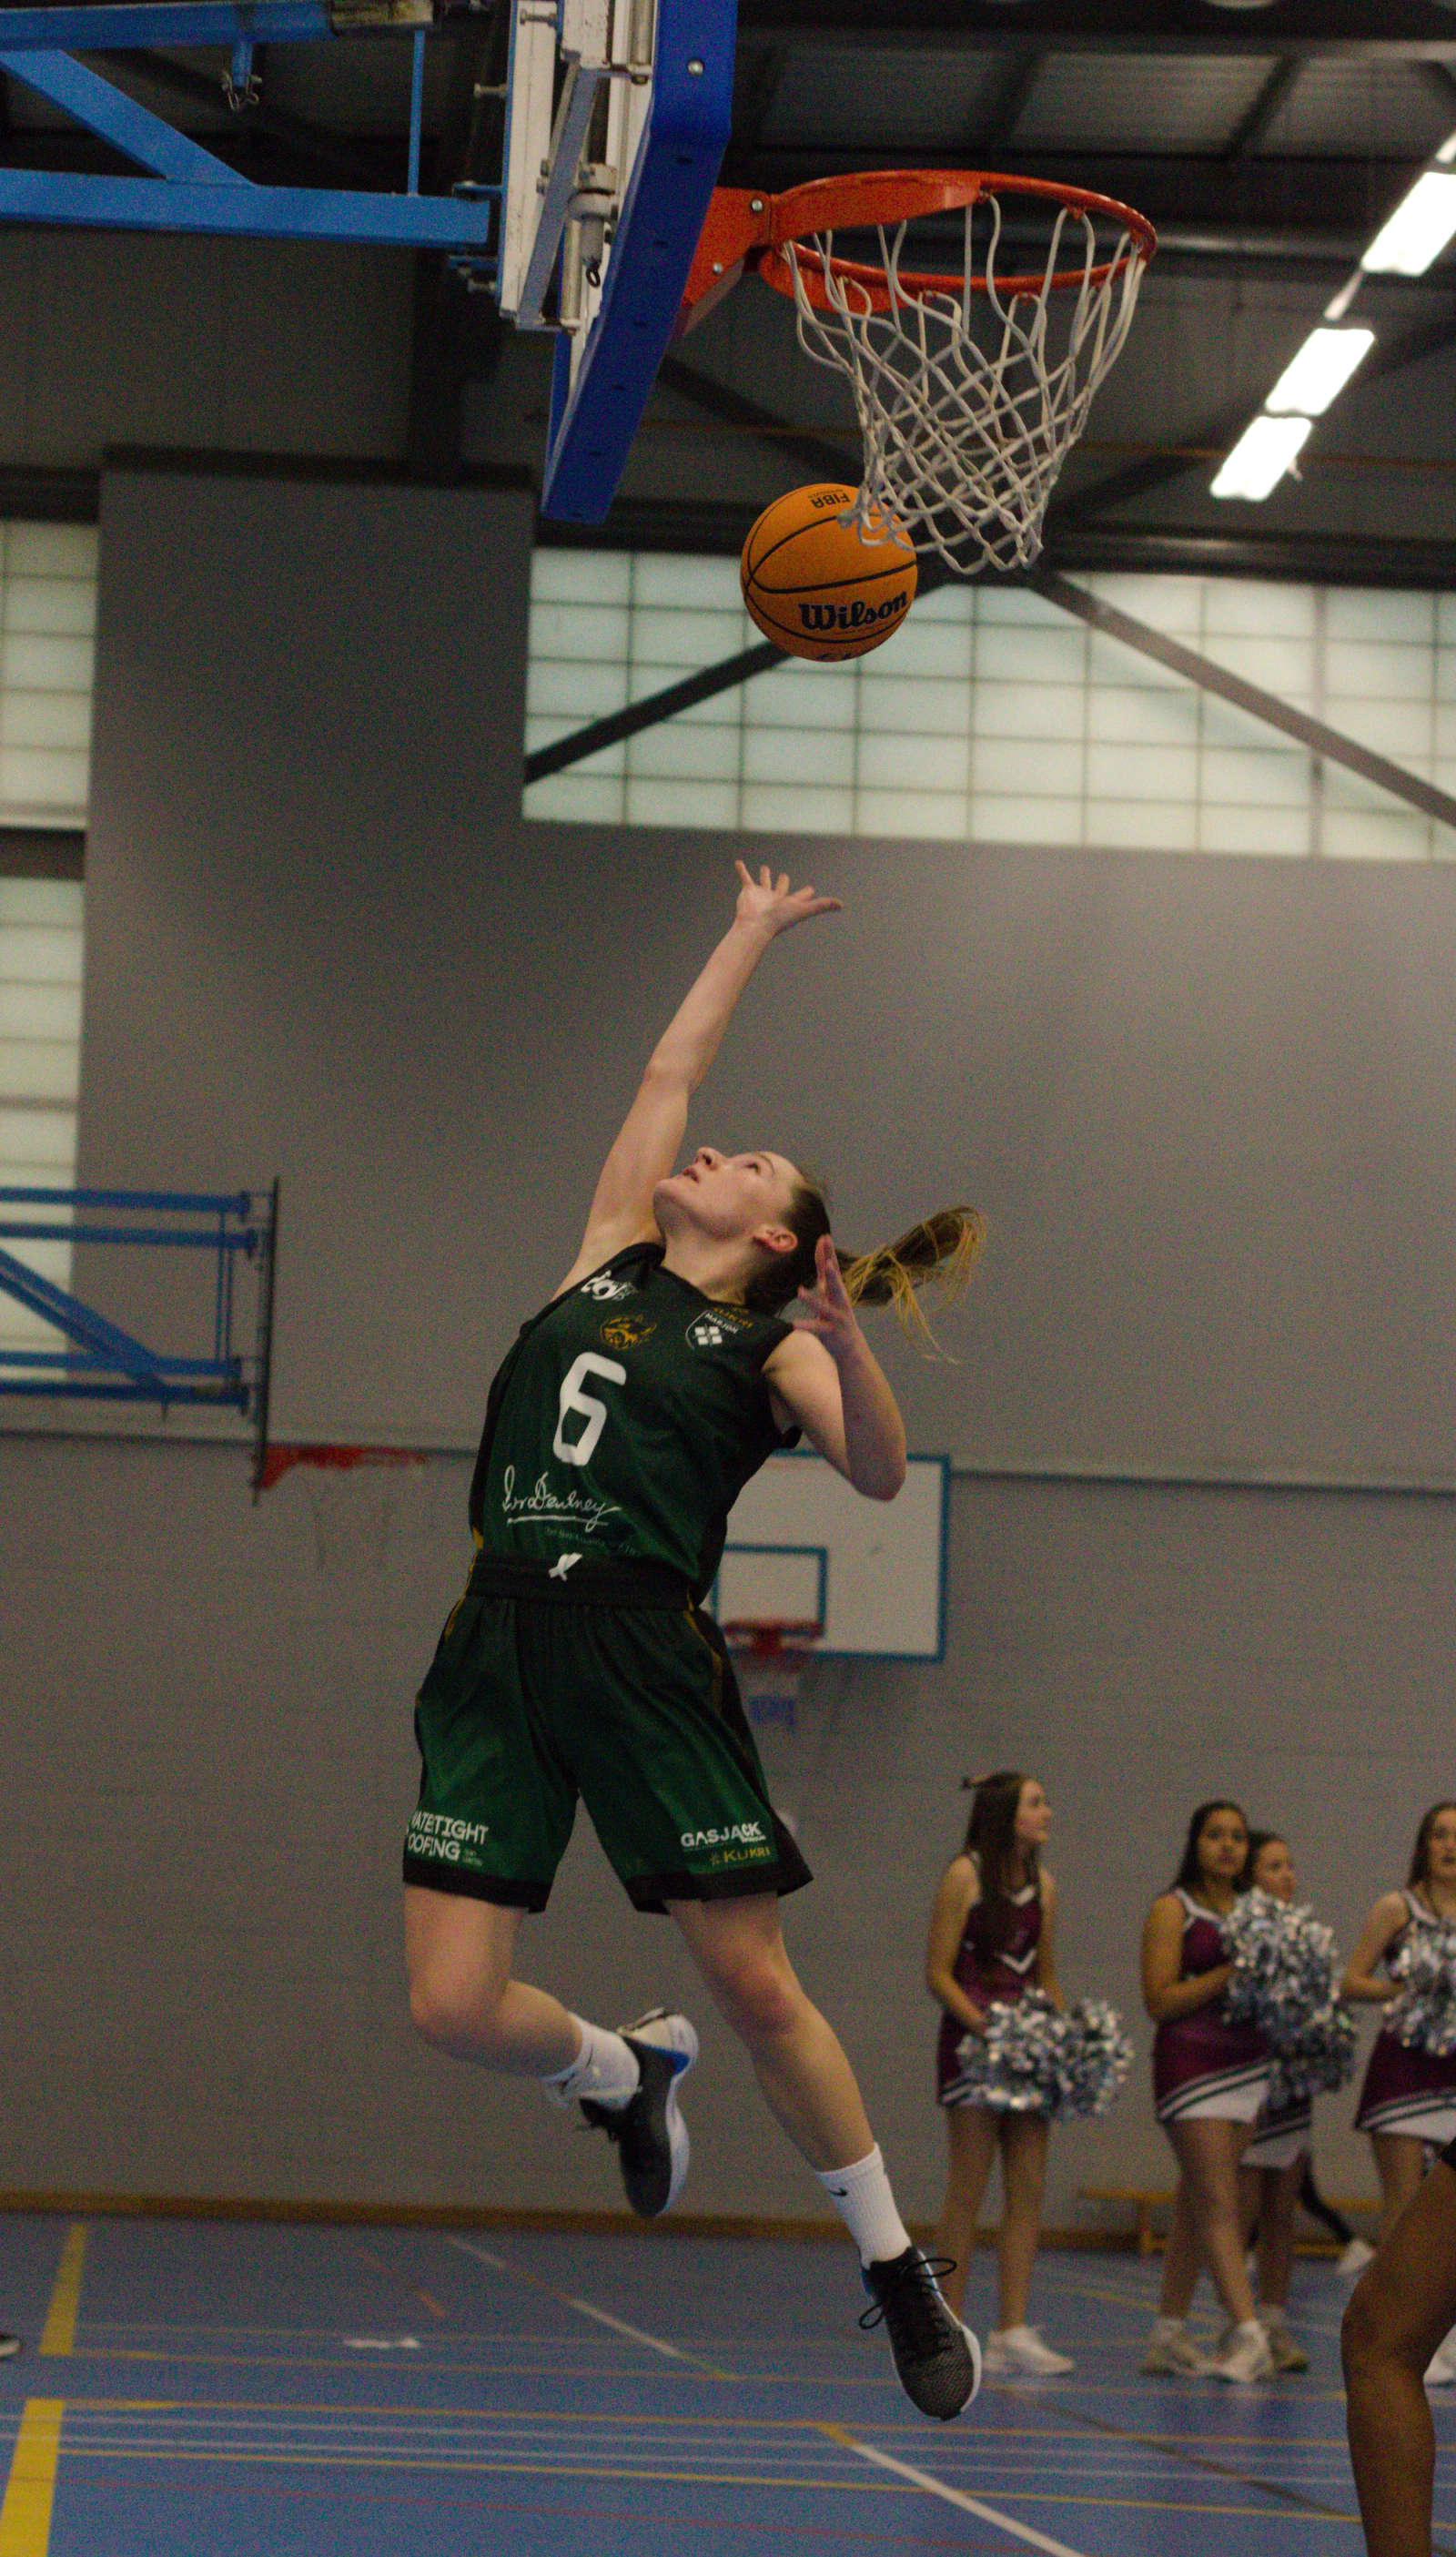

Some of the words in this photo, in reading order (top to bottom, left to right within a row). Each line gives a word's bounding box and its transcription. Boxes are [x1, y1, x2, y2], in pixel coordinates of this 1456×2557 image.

[811, 492, 851, 509] FIBA
[798, 591, 907, 631] Wilson
[552, 1352, 627, 1466] 6
[680, 1821, 763, 1848] GASJACK
[723, 1846, 772, 1863] KUKRI
